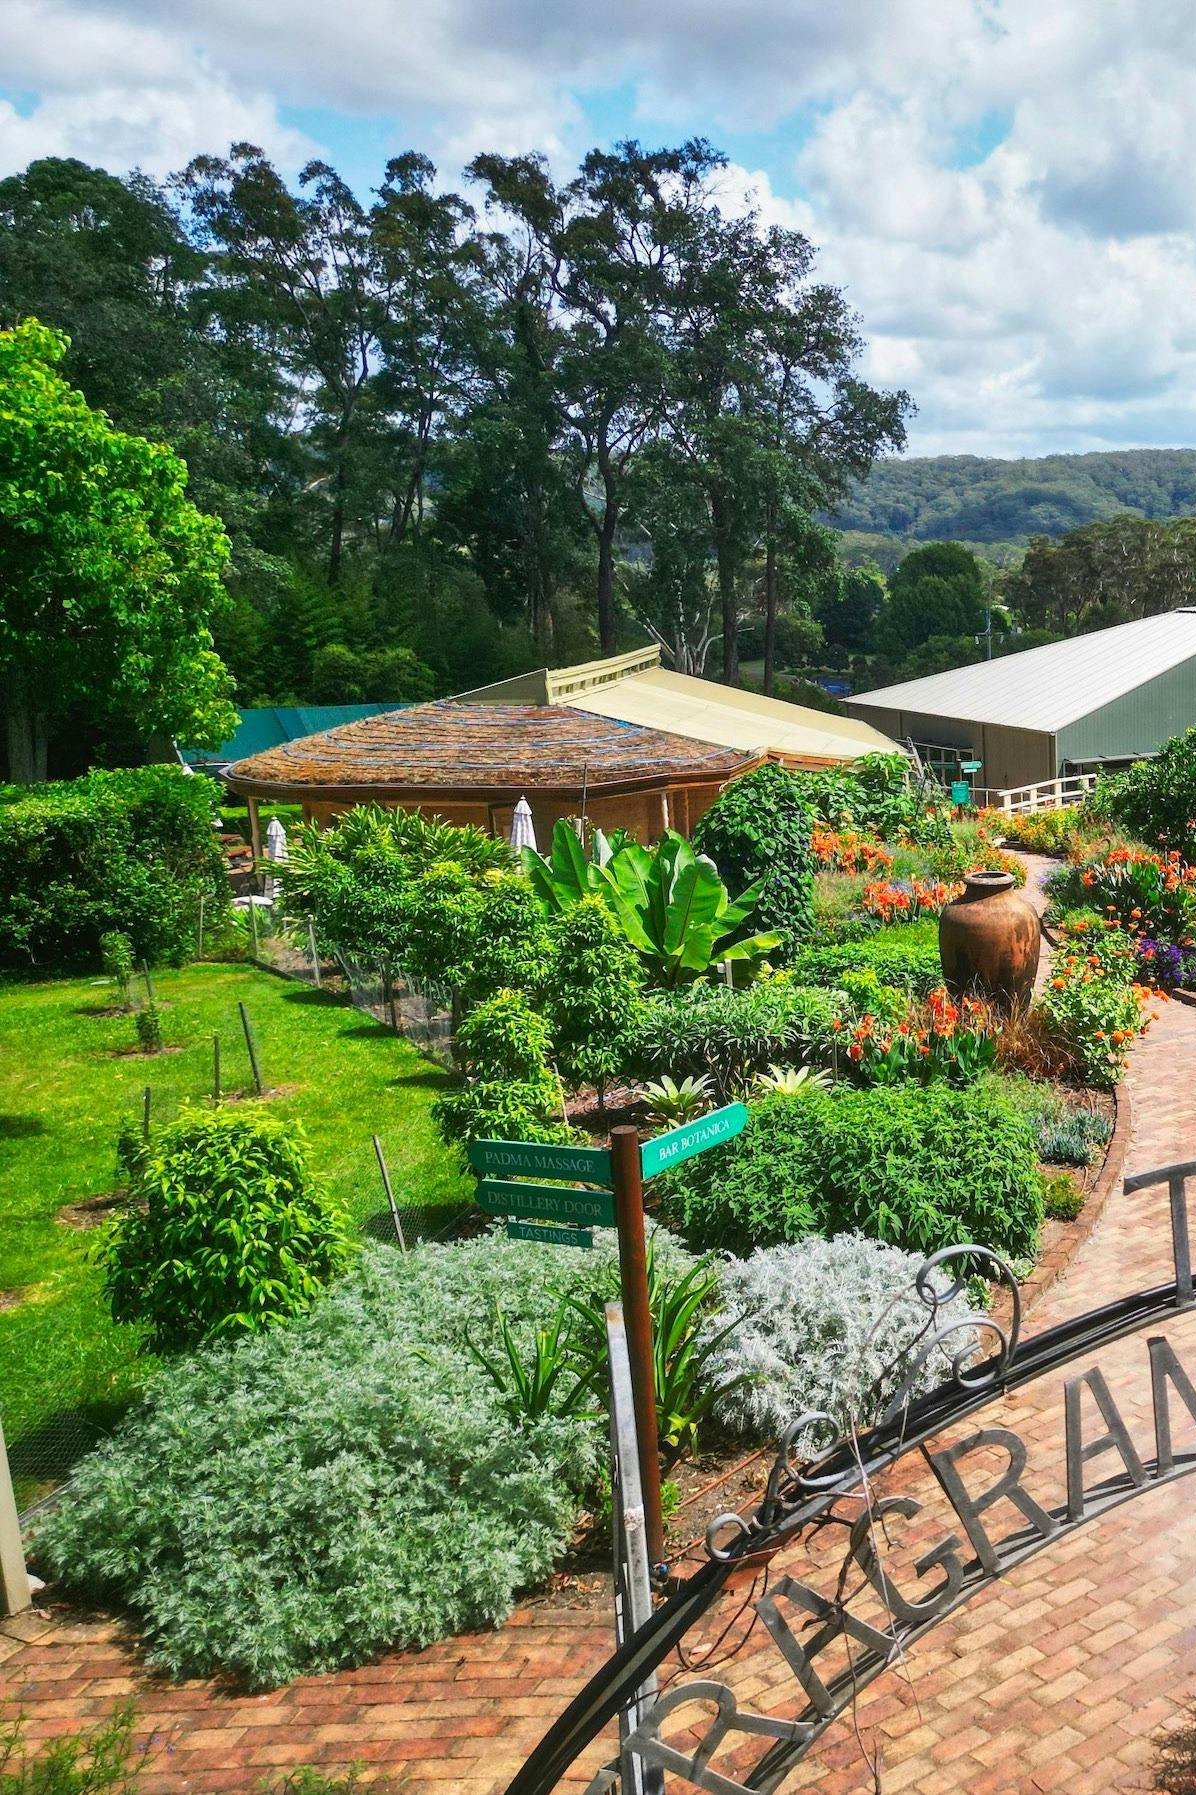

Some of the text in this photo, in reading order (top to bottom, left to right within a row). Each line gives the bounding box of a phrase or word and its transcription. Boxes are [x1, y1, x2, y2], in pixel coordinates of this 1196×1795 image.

[659, 1119, 730, 1161] BAR BOTANICA
[485, 1151, 596, 1174] PADMA MASSAGE
[488, 1191, 603, 1217] DISTILLERY DOOR
[519, 1226, 578, 1244] TASTINGS
